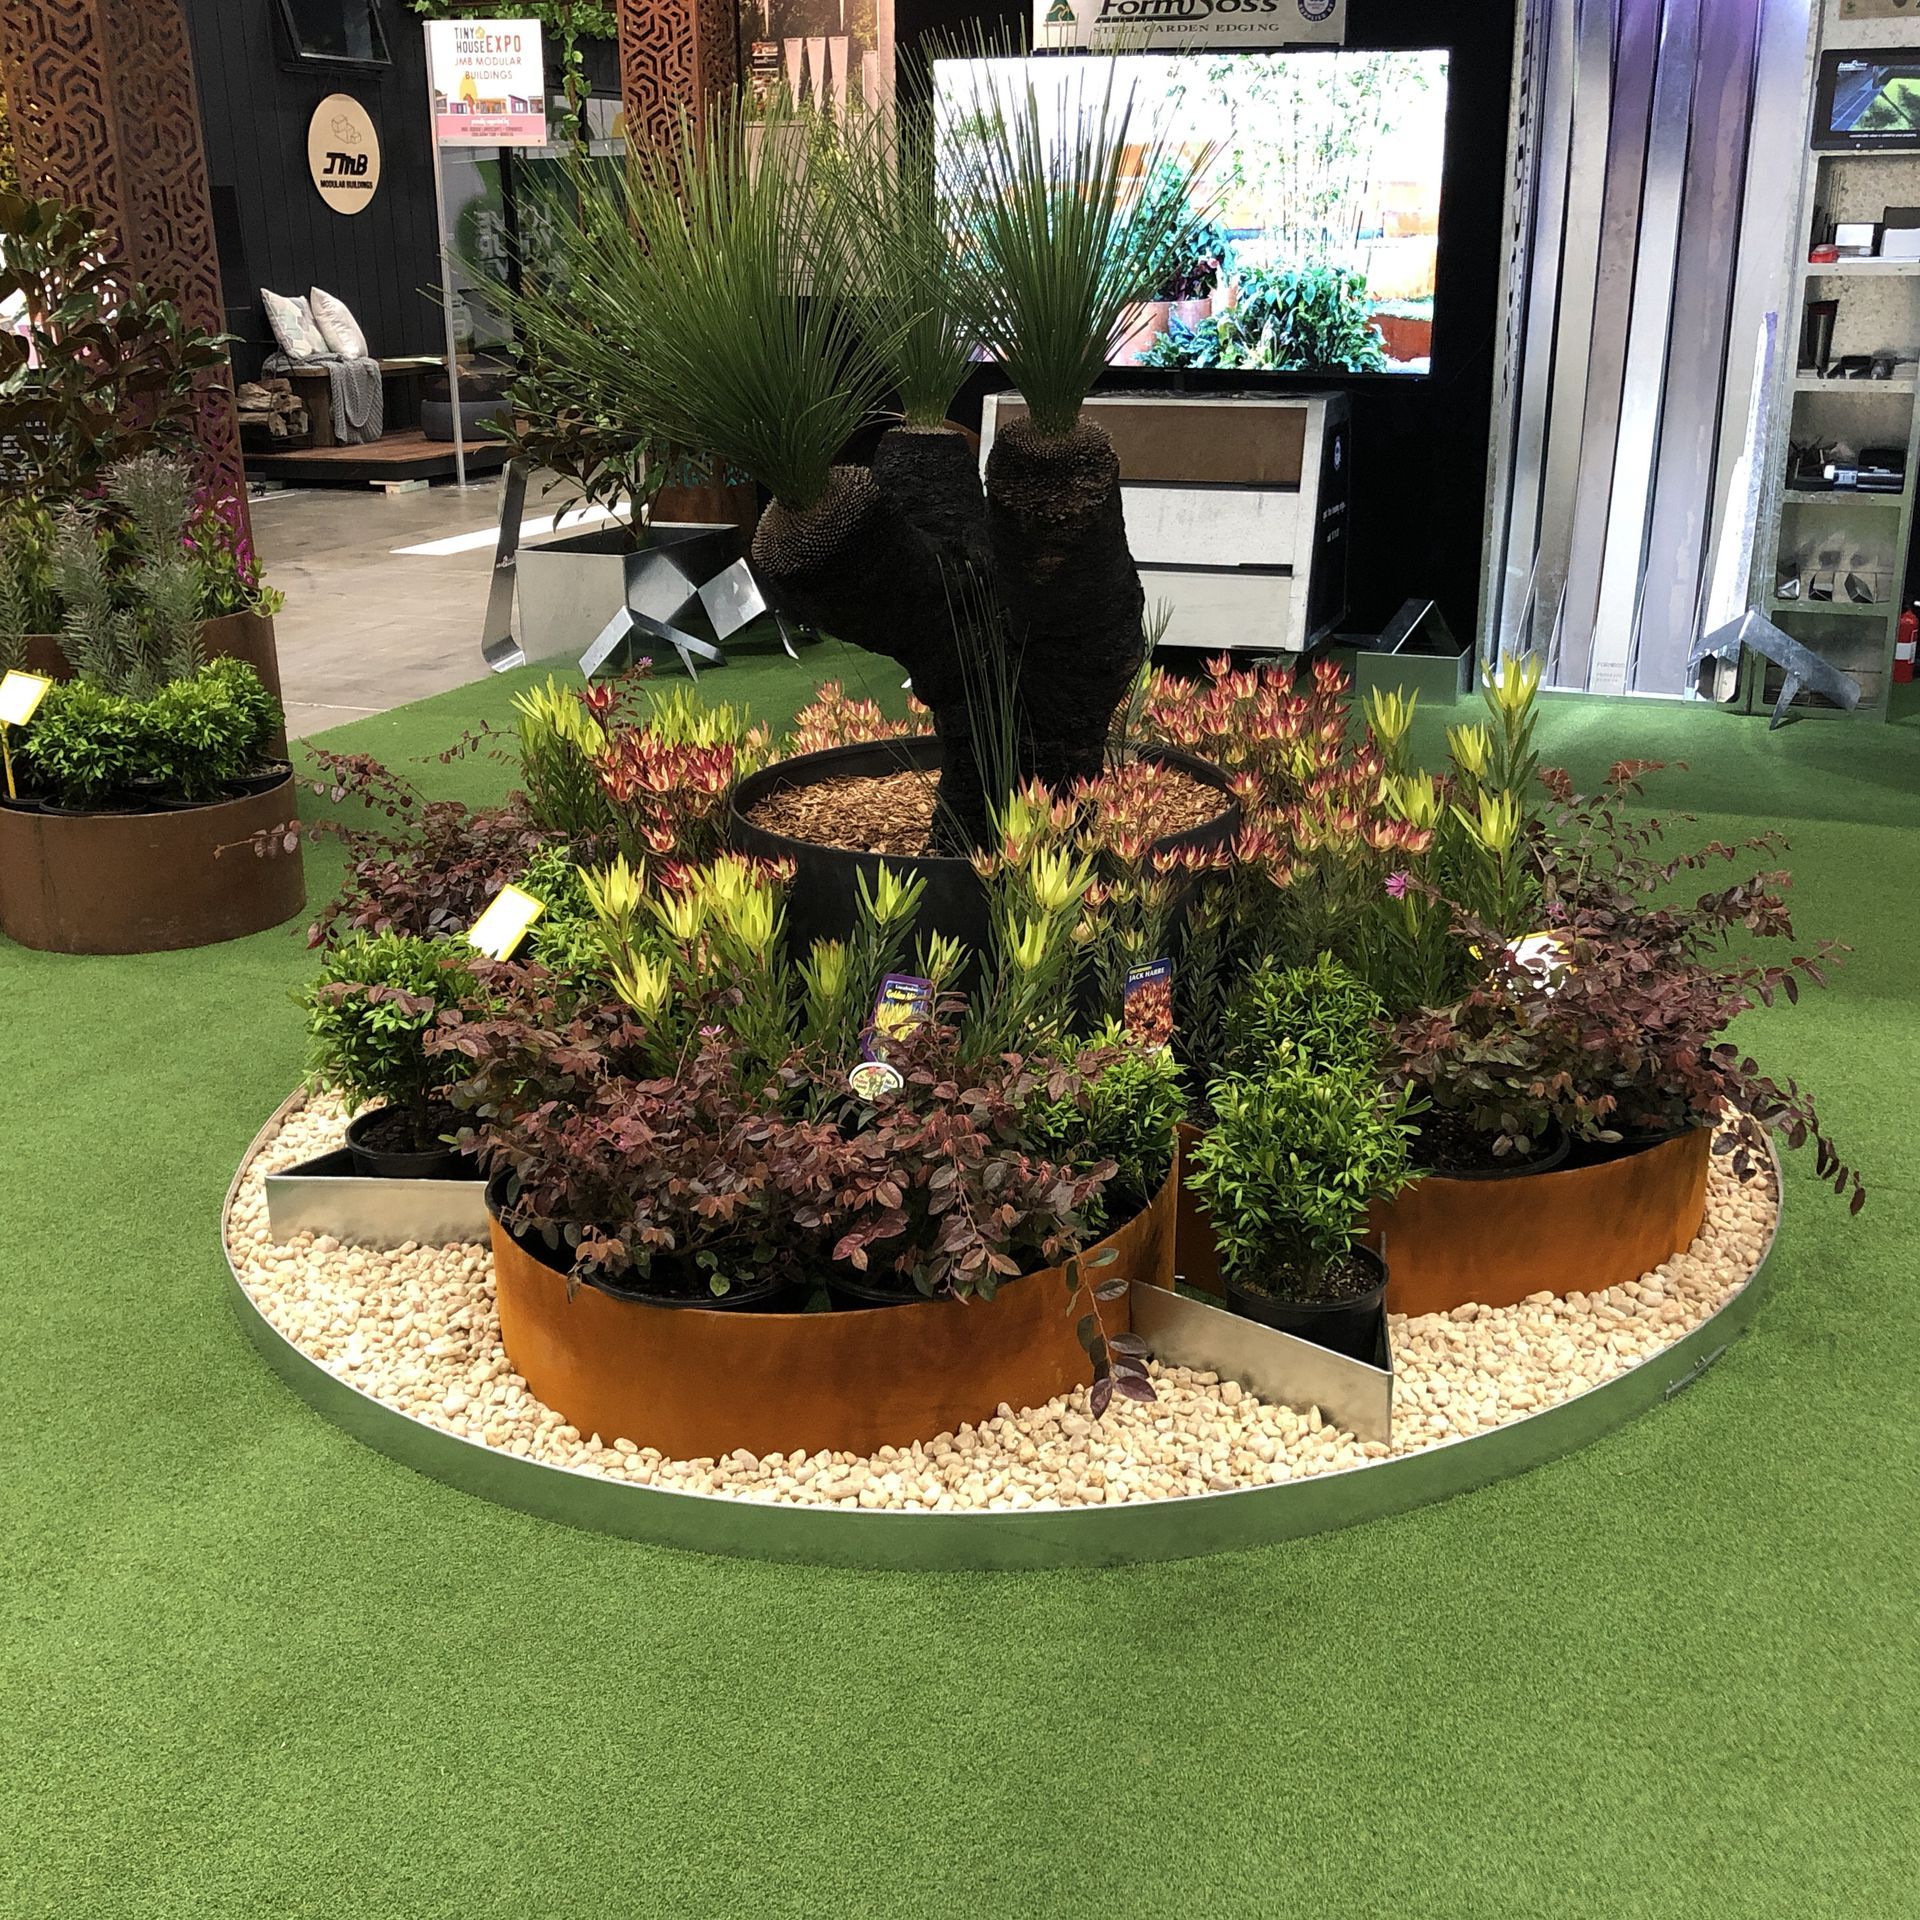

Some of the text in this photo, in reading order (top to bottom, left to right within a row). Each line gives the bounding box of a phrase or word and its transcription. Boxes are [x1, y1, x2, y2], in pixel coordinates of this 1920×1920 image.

[454, 26, 474, 39] TINY
[1093, 23, 1280, 34] STEEL GARDEN EDGING
[456, 41, 485, 53] HOUSE
[486, 35, 521, 53] EXPO
[455, 56, 522, 66] JMB MODULAR
[465, 70, 512, 80] BUILDINGS
[320, 180, 373, 189] MODULAR BUILDINGS
[1129, 971, 1144, 983] JACK
